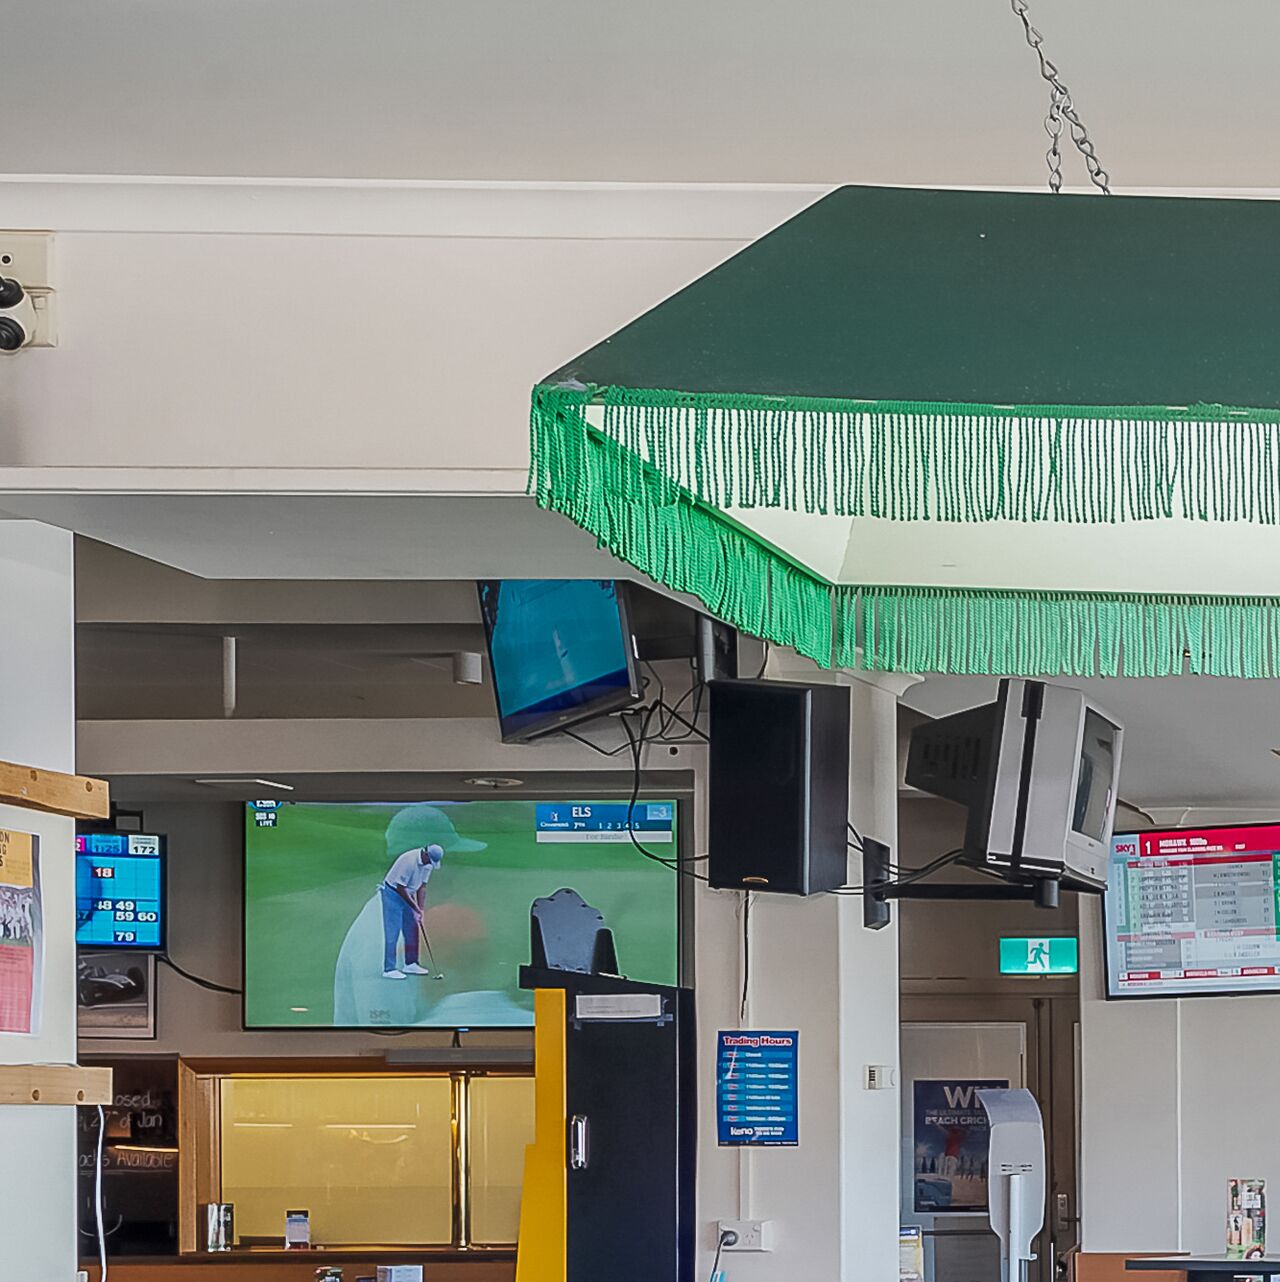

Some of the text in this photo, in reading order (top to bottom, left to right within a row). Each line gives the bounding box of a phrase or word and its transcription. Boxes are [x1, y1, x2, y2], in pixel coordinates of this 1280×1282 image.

[572, 806, 592, 818] ELS
[95, 868, 112, 878] 18
[115, 901, 134, 911] 49
[115, 911, 134, 921] 59
[138, 912, 156, 921] 60
[115, 932, 134, 942] 79
[724, 1036, 792, 1047] Trading Hours
[114, 1090, 150, 1107] osed
[137, 1111, 163, 1128] Jan
[116, 1150, 174, 1169] Available
